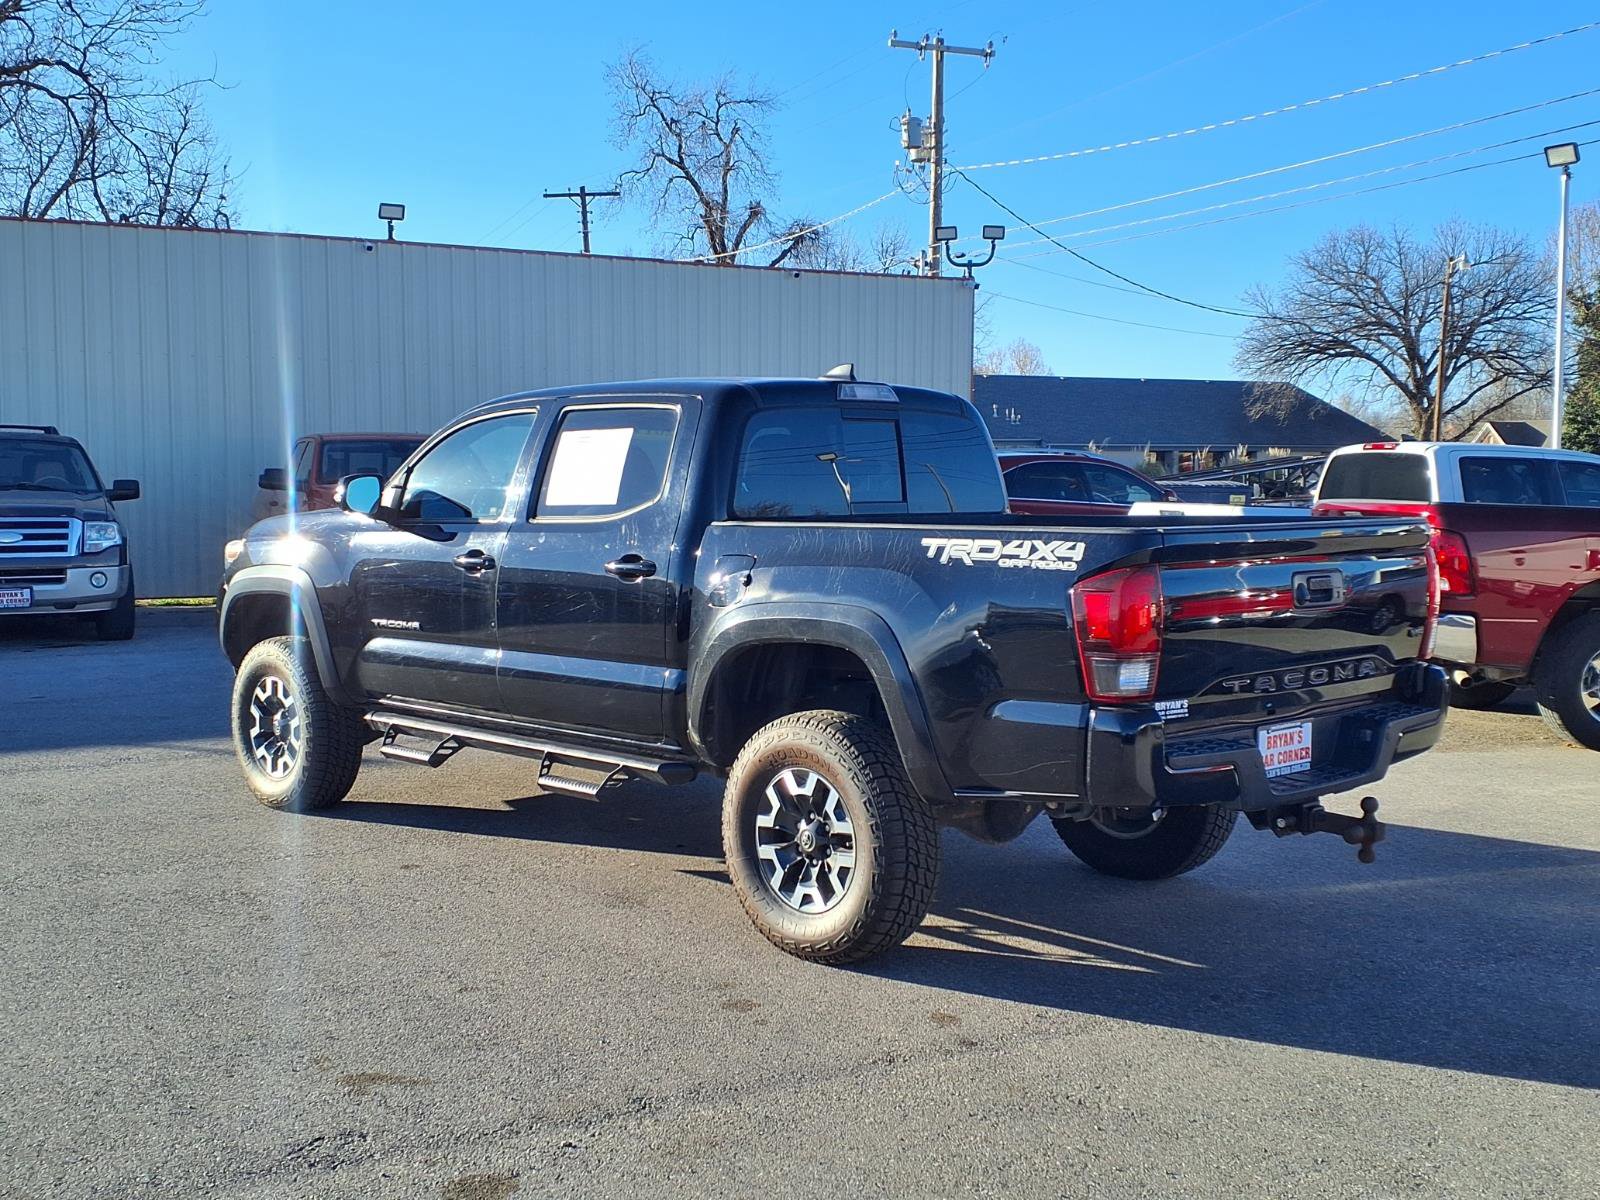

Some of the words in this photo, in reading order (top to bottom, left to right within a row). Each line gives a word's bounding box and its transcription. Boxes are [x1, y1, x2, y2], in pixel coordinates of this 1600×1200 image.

[998, 558, 1030, 569] OFF
[1030, 559, 1078, 571] ROAD
[370, 618, 420, 630] TACOMA
[1222, 659, 1376, 695] TACOMA
[1154, 699, 1189, 711] BRYAN'S
[1266, 730, 1303, 750] BRYAN'S
[1264, 753, 1274, 767] AR
[1277, 746, 1310, 765] CORNER
